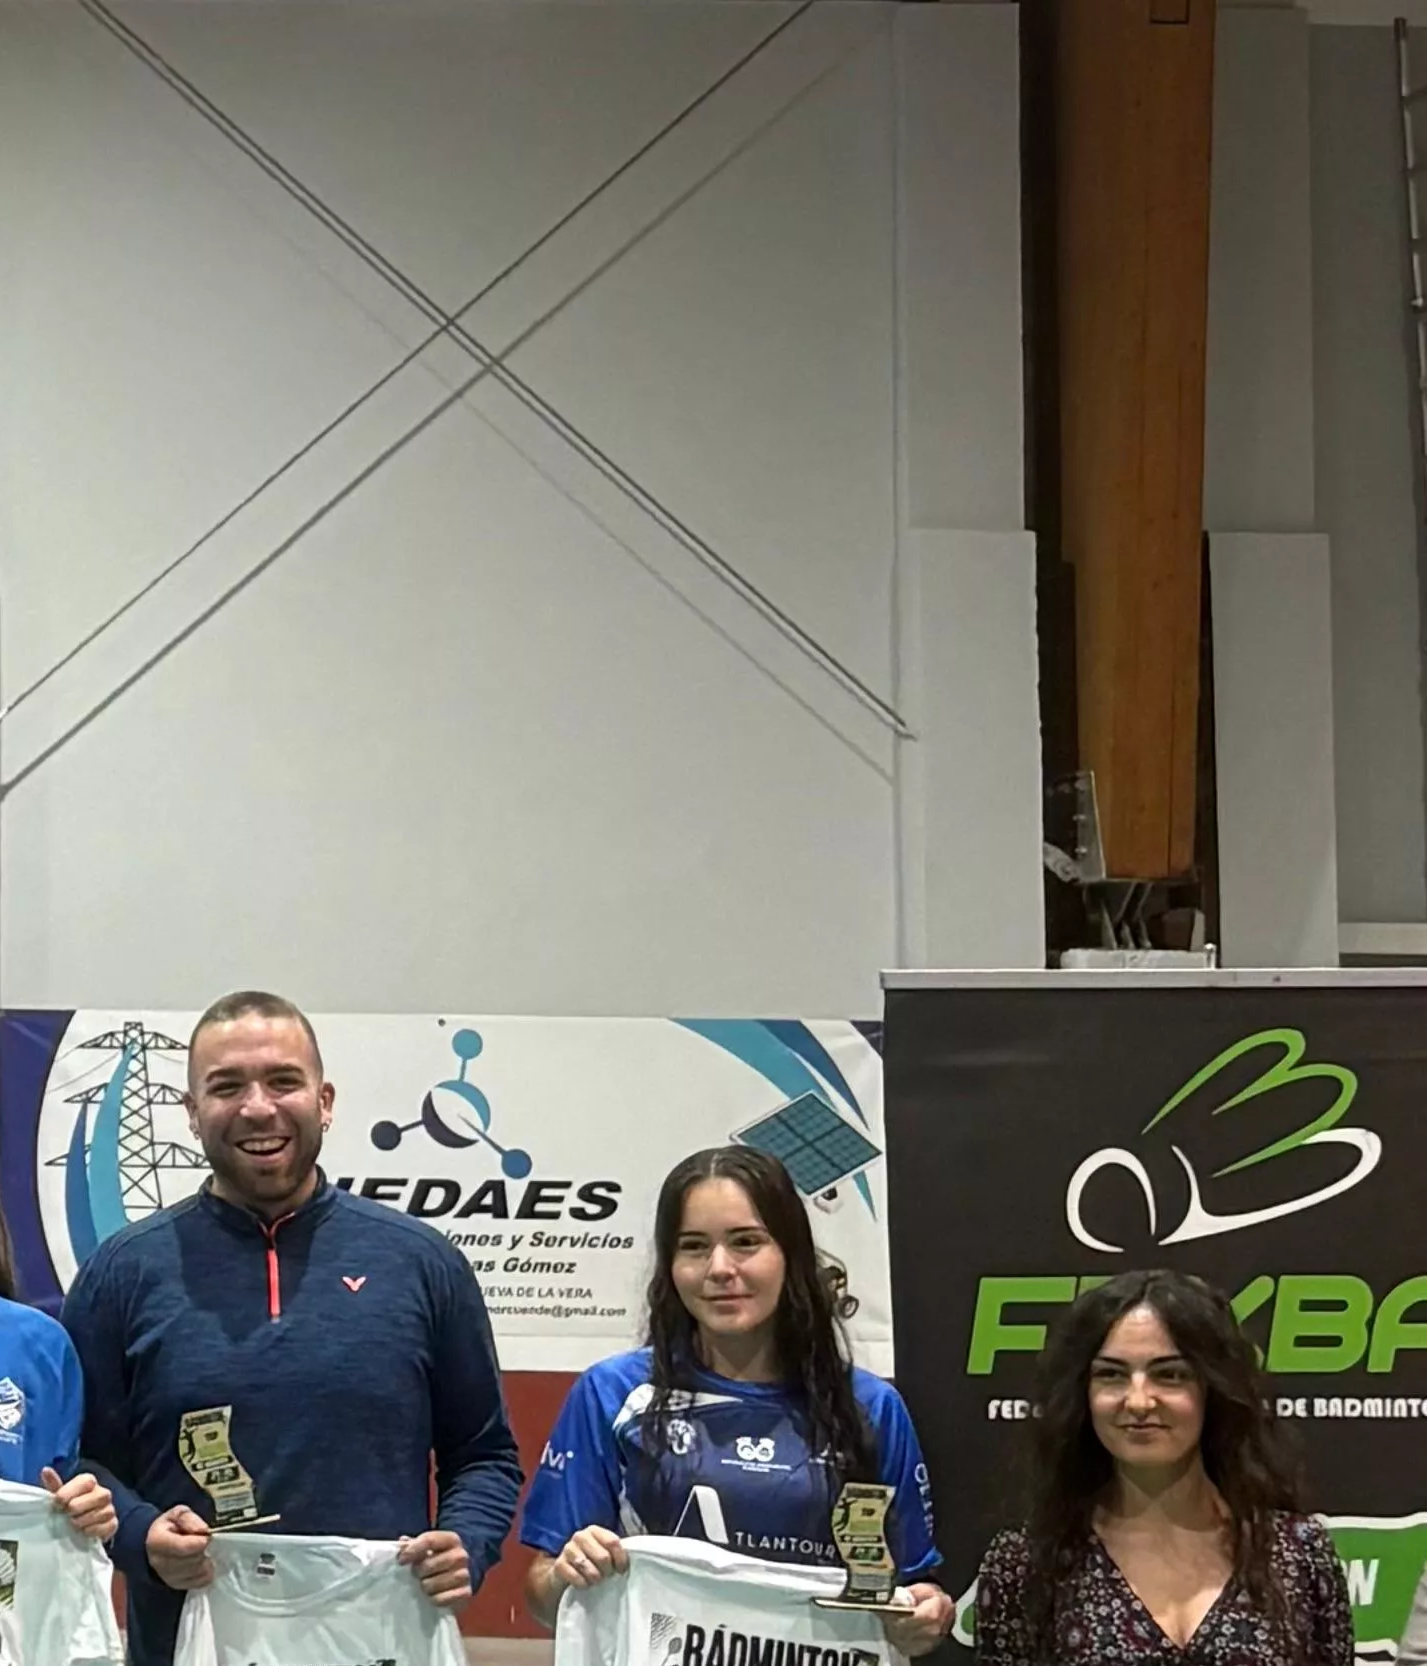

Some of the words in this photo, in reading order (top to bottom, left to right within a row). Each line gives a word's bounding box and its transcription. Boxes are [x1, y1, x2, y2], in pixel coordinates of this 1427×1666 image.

[337, 1176, 623, 1221] EDAES
[445, 1230, 501, 1246] iones
[507, 1232, 525, 1250] y
[529, 1232, 634, 1249] Servicios
[503, 1258, 577, 1274] Gómez
[481, 1287, 515, 1297] UEVA
[517, 1287, 534, 1298] DE
[538, 1288, 554, 1298] LA
[559, 1288, 593, 1298] VERA
[1277, 1398, 1307, 1417] DE
